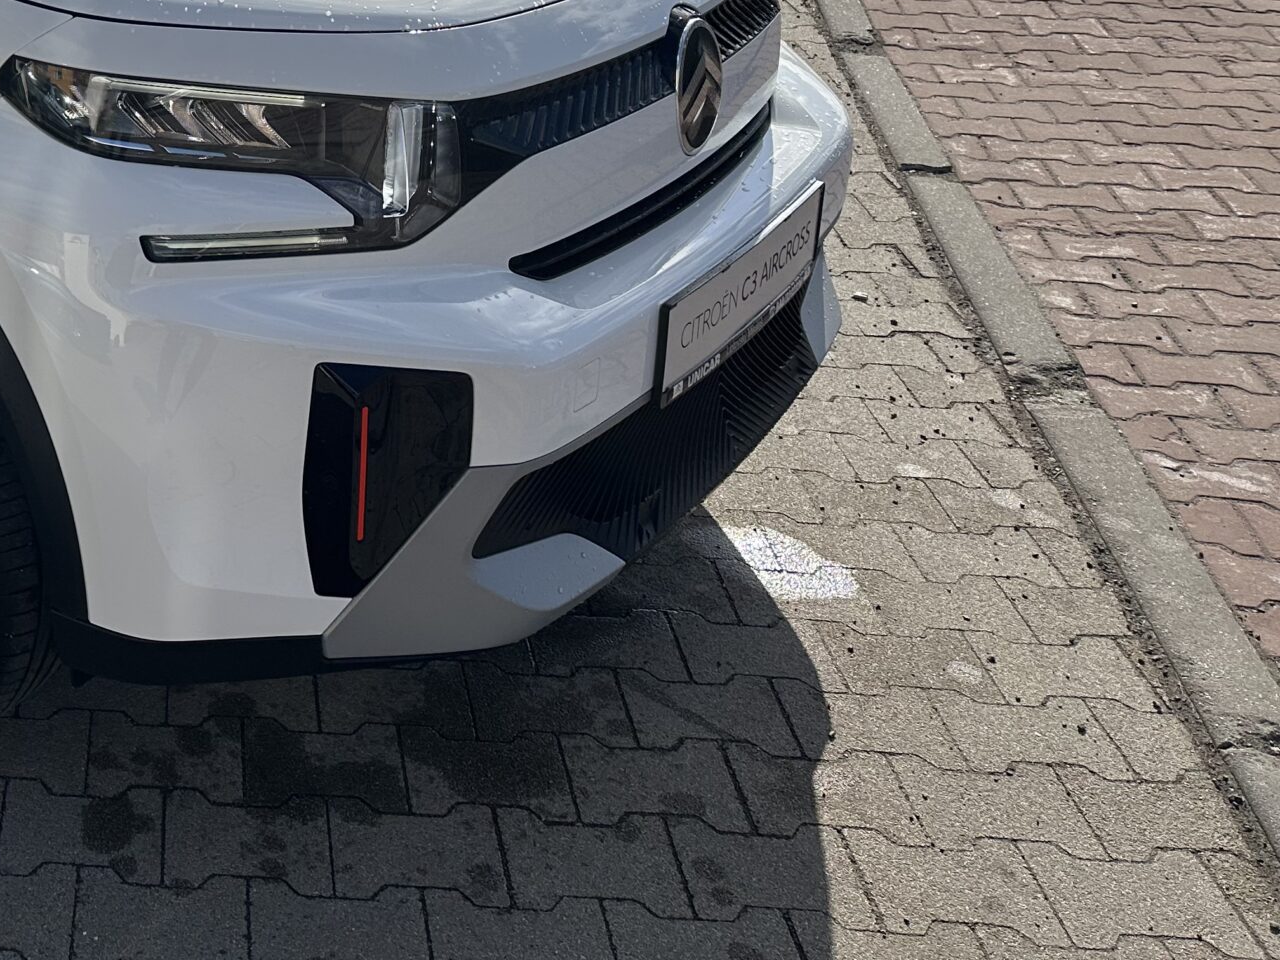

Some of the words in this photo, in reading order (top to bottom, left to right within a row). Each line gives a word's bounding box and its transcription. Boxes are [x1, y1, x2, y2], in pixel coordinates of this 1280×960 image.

[681, 284, 739, 348] CITROËN
[741, 270, 758, 302] C3
[759, 220, 811, 288] AIRCROSS
[687, 353, 721, 387] UNICAR
